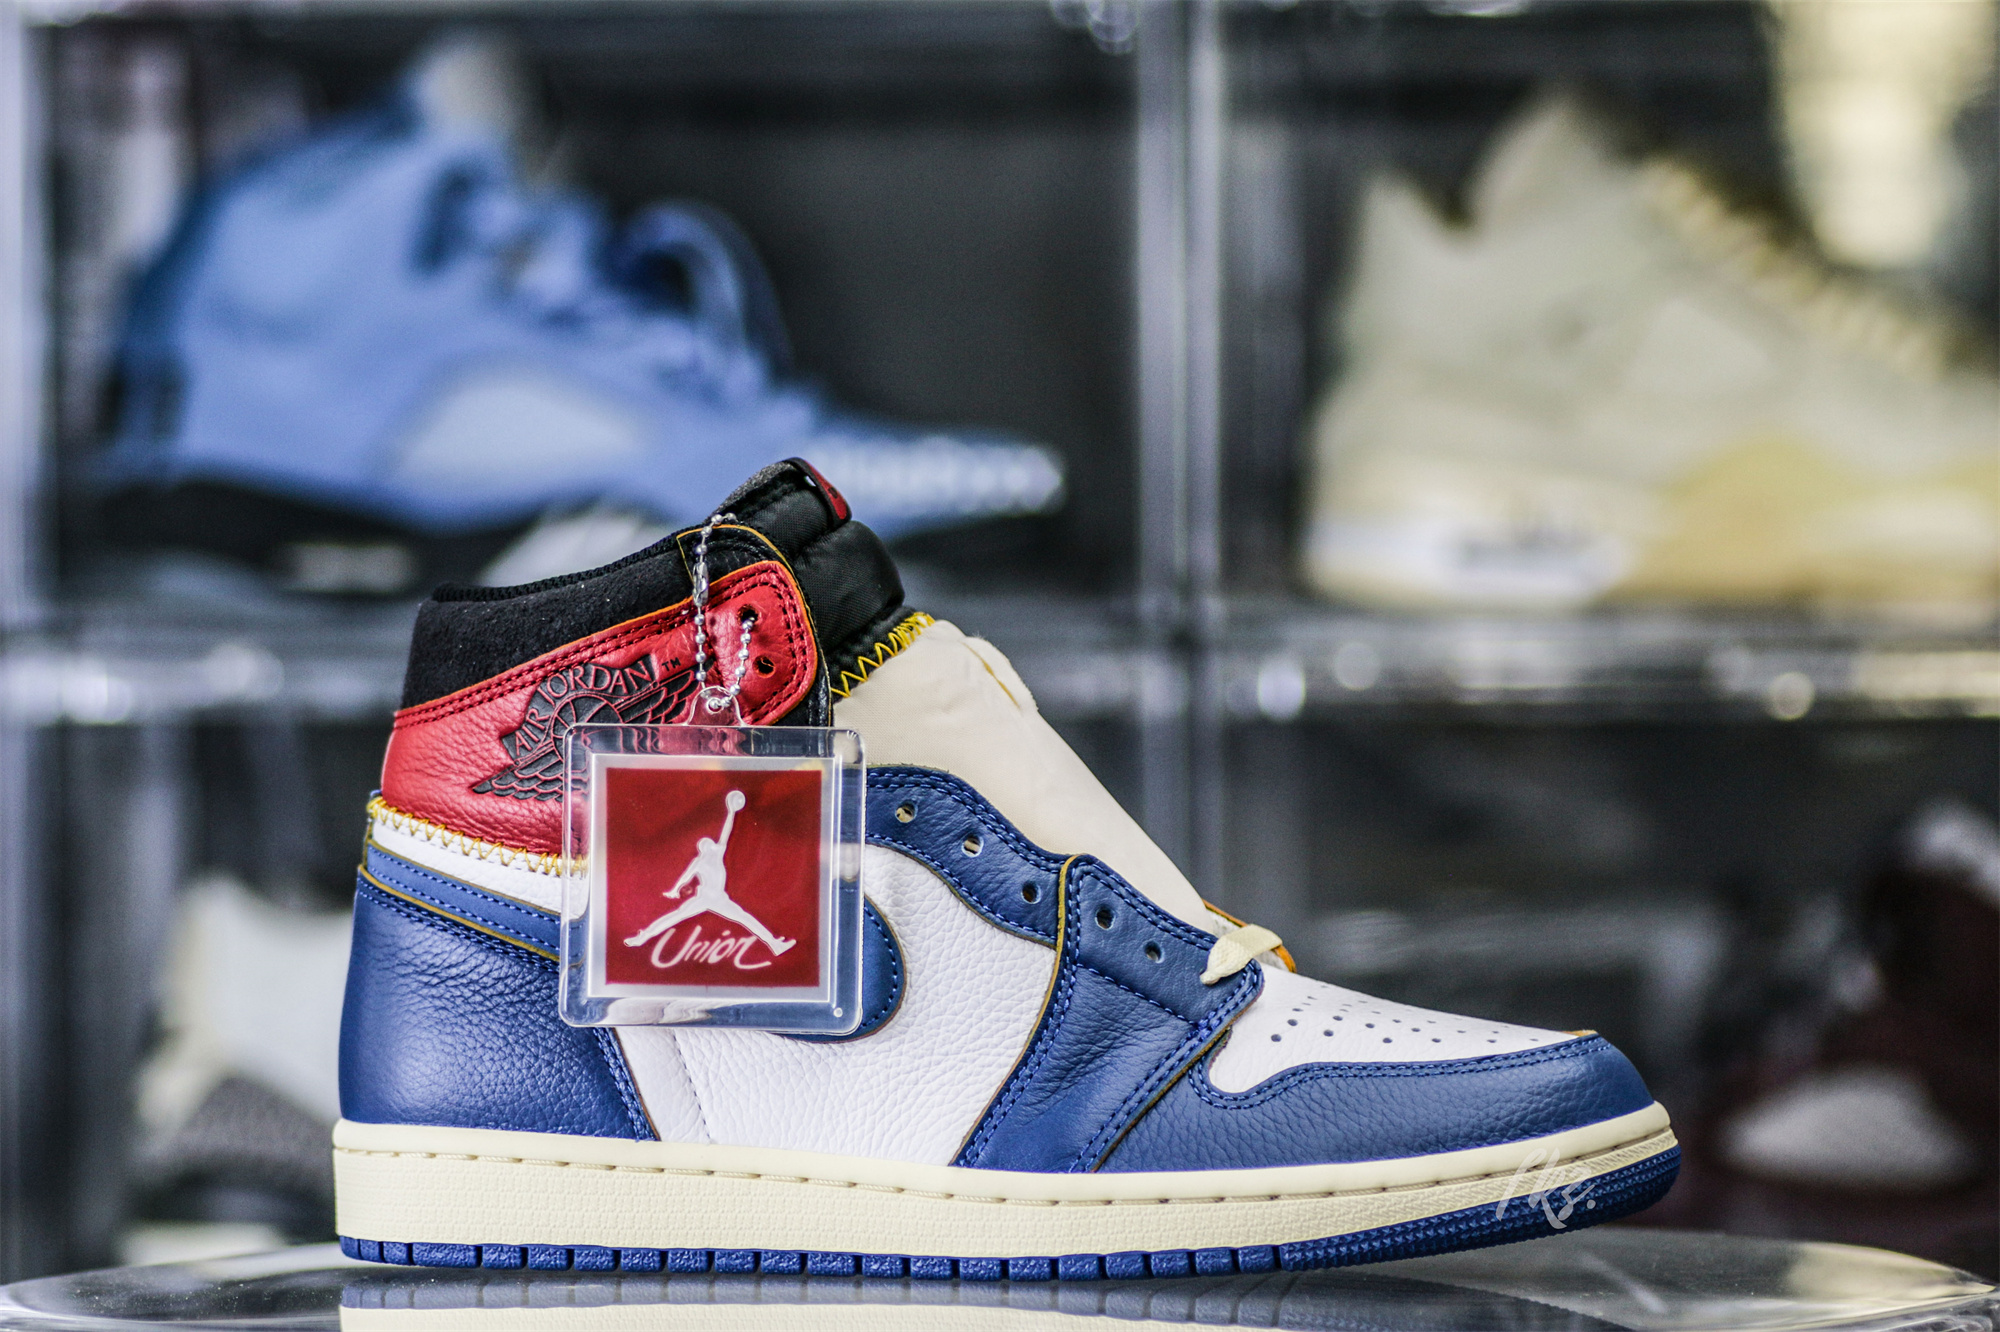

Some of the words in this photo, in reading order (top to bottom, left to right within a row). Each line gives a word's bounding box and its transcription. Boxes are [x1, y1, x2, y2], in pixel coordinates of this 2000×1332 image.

[514, 708, 551, 756] AIR
[537, 660, 653, 707] JORDAN
[651, 925, 772, 969] Union
